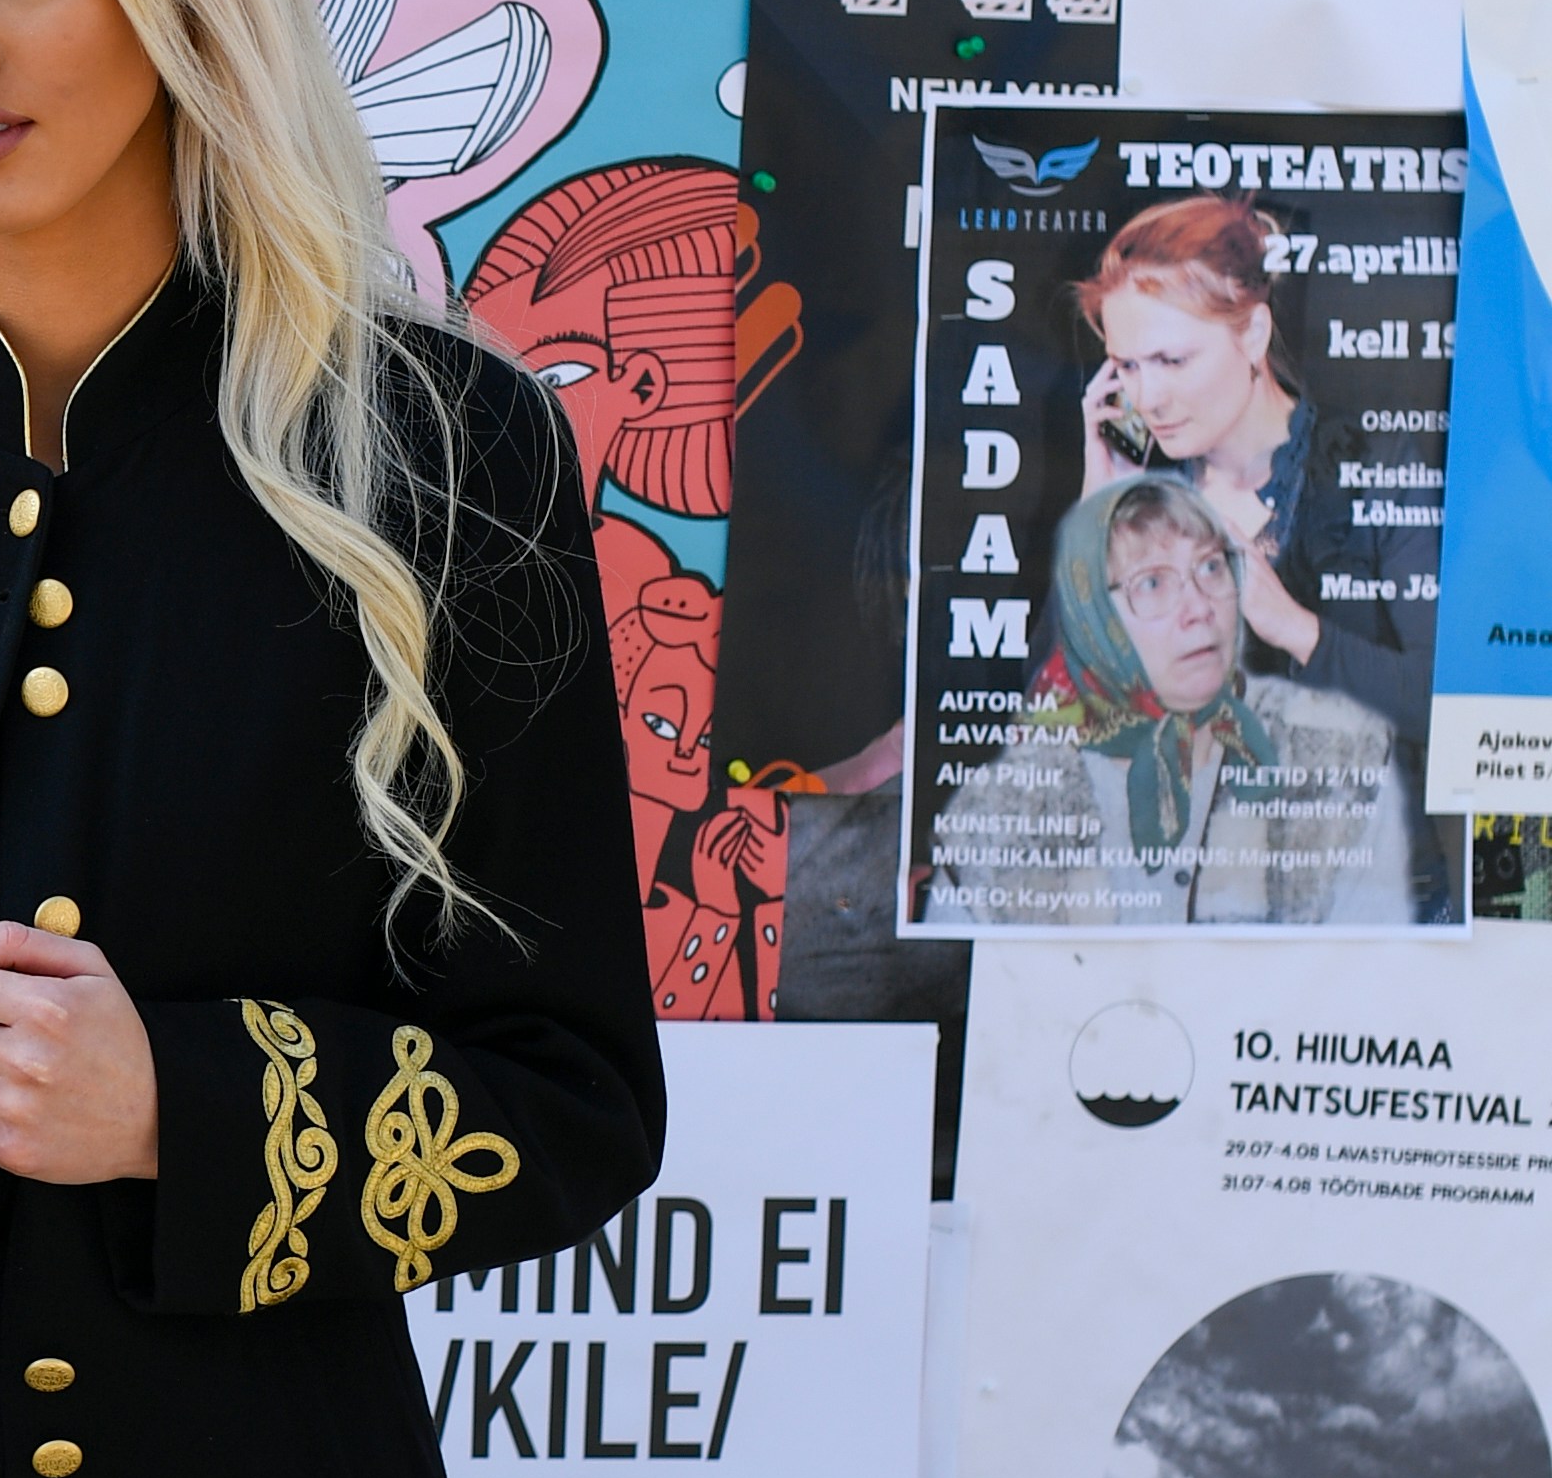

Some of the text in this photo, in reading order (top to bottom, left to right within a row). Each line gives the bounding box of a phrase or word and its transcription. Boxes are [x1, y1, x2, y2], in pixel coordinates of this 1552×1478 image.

[1118, 141, 1468, 194] TEOTEATRIS
[960, 207, 1108, 234] LENDTEATER
[1328, 319, 1408, 359] kell
[1360, 409, 1450, 433] OSADES
[1338, 461, 1445, 489] Kristiin
[1321, 574, 1397, 601] Mare
[938, 690, 1059, 715] AUTOR JA
[937, 724, 1081, 746] LAVASTAJA
[995, 764, 1064, 792] Pajur
[1220, 765, 1307, 788] PILETID
[1475, 760, 1527, 781] Pilet
[1230, 796, 1378, 821] lendteater.ee
[933, 813, 1077, 835] KUNSTILINE
[931, 846, 1098, 868] MUUSIKALINE
[1100, 846, 1235, 868] KUJUNDUS:
[930, 887, 1014, 909] VIDEO:
[1095, 889, 1163, 909] Kroon
[1234, 1028, 1453, 1072] 10. HIIUMAA
[1230, 1082, 1533, 1128] TANTSUFESTIVAL
[1319, 1178, 1535, 1206] TÖÖTUBADE PROGRAMM
[759, 1196, 850, 1317] EI
[431, 1339, 748, 1461] /KILE/
